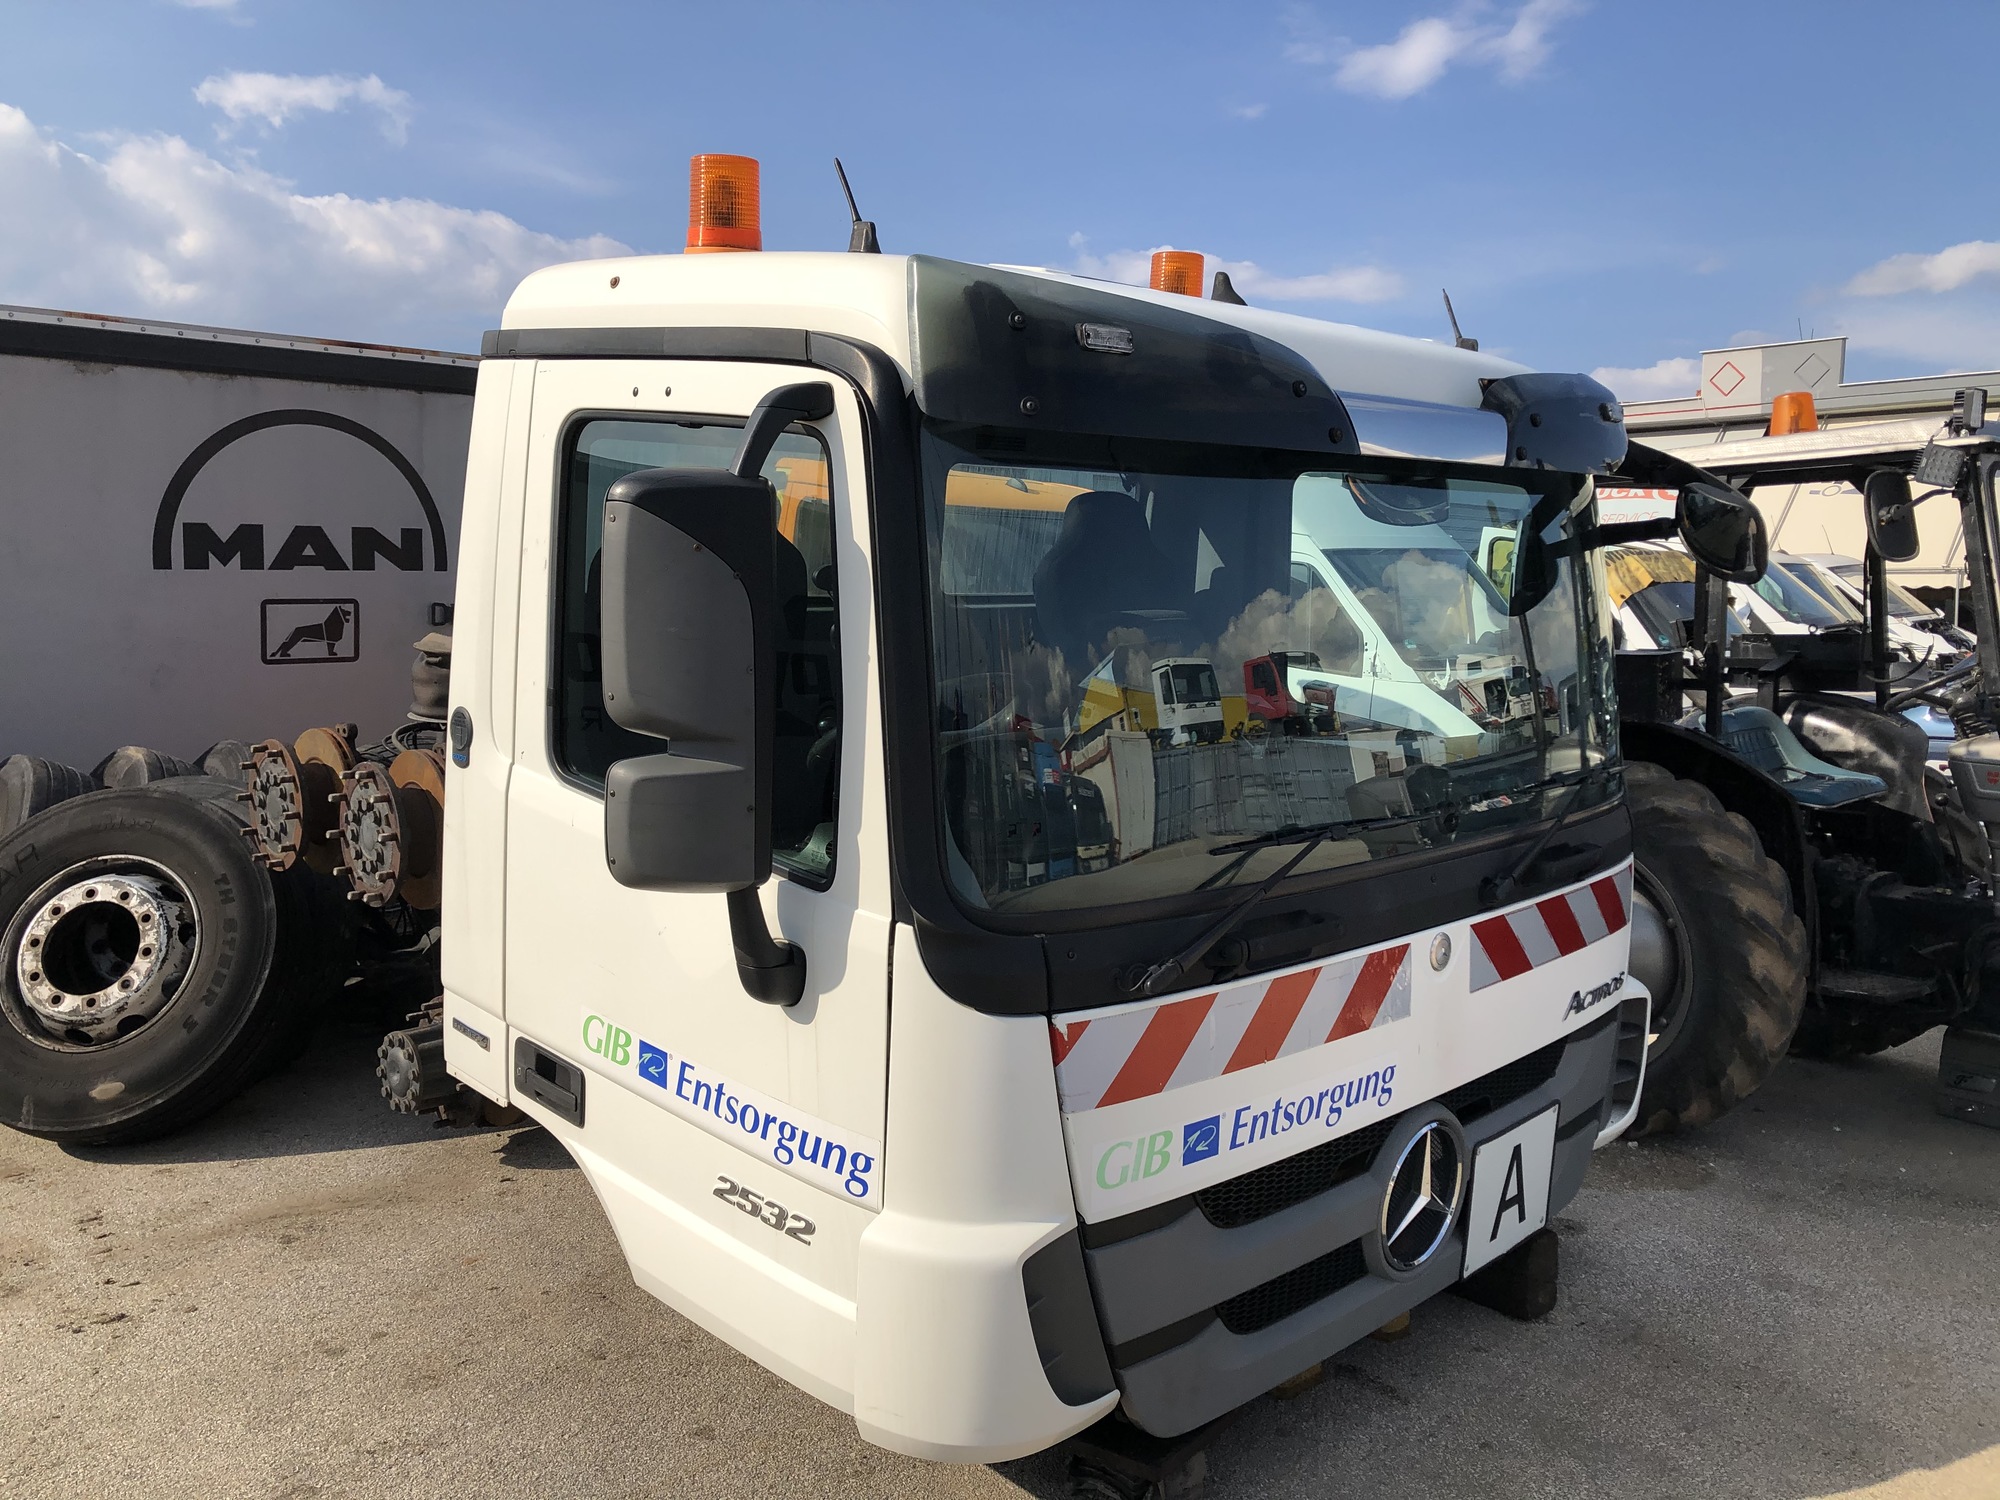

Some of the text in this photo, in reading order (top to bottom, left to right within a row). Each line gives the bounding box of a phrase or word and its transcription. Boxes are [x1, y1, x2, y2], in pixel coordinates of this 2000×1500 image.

[182, 522, 423, 571] MAN
[582, 1014, 875, 1198] GIB Entsorgung
[1096, 1063, 1397, 1190] GIB Entsorgung
[712, 1174, 817, 1246] 2532
[1490, 1142, 1526, 1243] A
